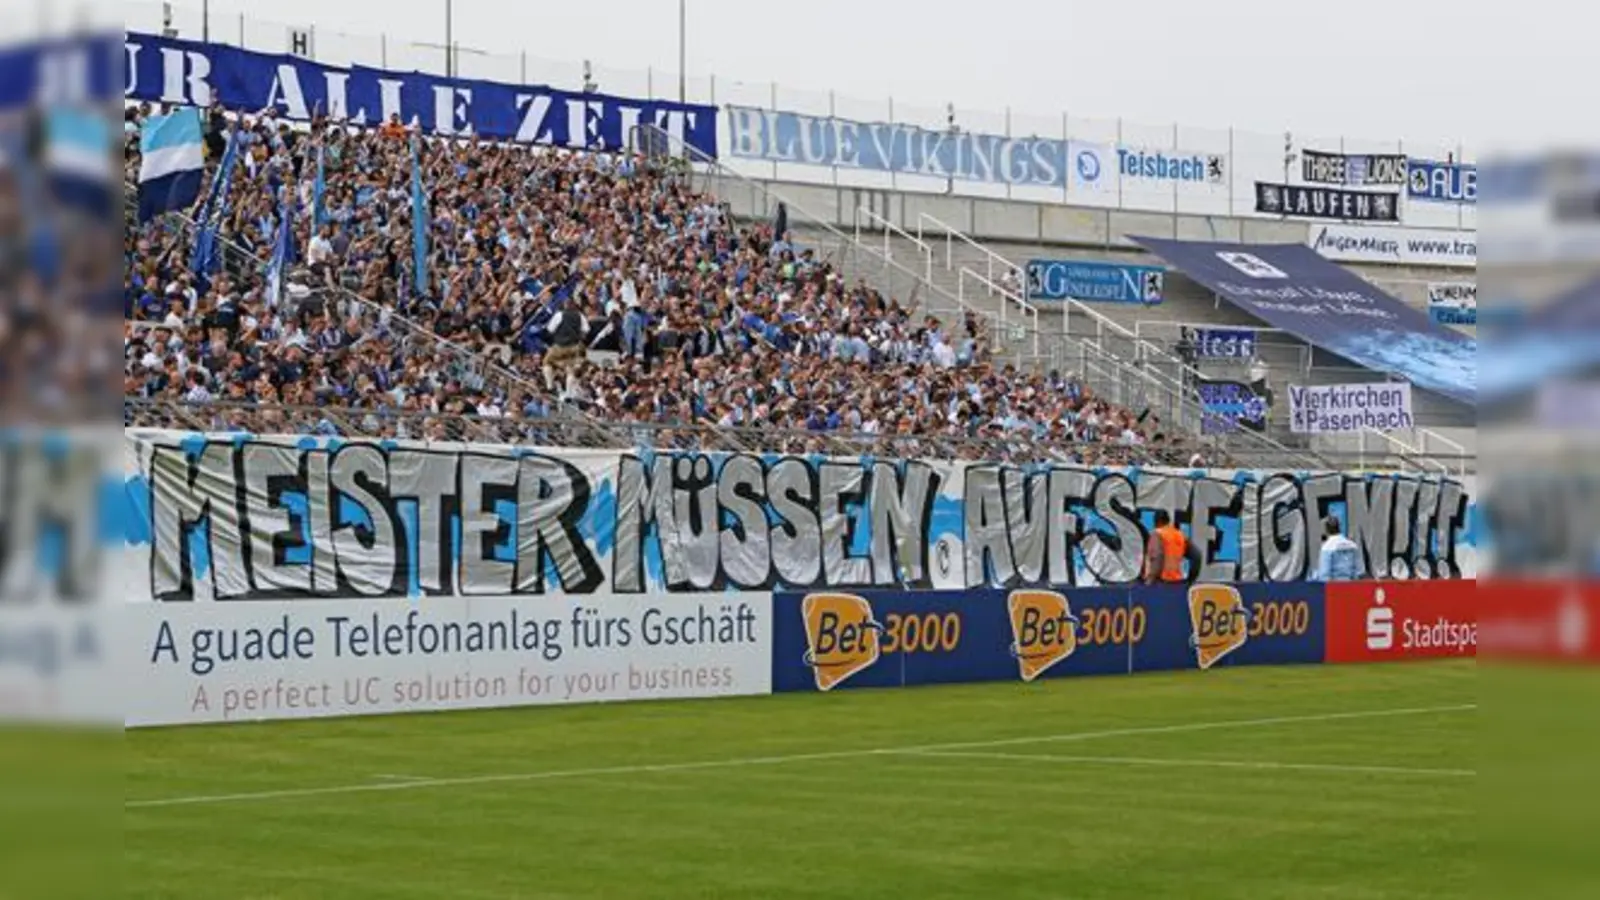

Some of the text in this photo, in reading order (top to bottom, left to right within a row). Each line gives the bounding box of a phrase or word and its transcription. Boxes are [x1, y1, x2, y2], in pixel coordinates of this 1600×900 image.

[293, 31, 306, 55] H
[267, 64, 472, 137] ALLE
[515, 93, 696, 157] ZEIT
[732, 107, 1062, 186] BLUE VIKINGS
[1116, 149, 1204, 181] Teisbach
[1303, 156, 1406, 184] THREE LIONS
[1283, 191, 1371, 217] LAUFEN
[1290, 385, 1402, 408] Vierkirchen
[1306, 408, 1411, 430] Pasenbach
[152, 442, 604, 600] MEISTER
[613, 453, 940, 592] MÜSSEN
[151, 606, 757, 675] A guade Telefonanlag fürs Gschäft
[192, 661, 733, 719] A perfect UC solution for your business
